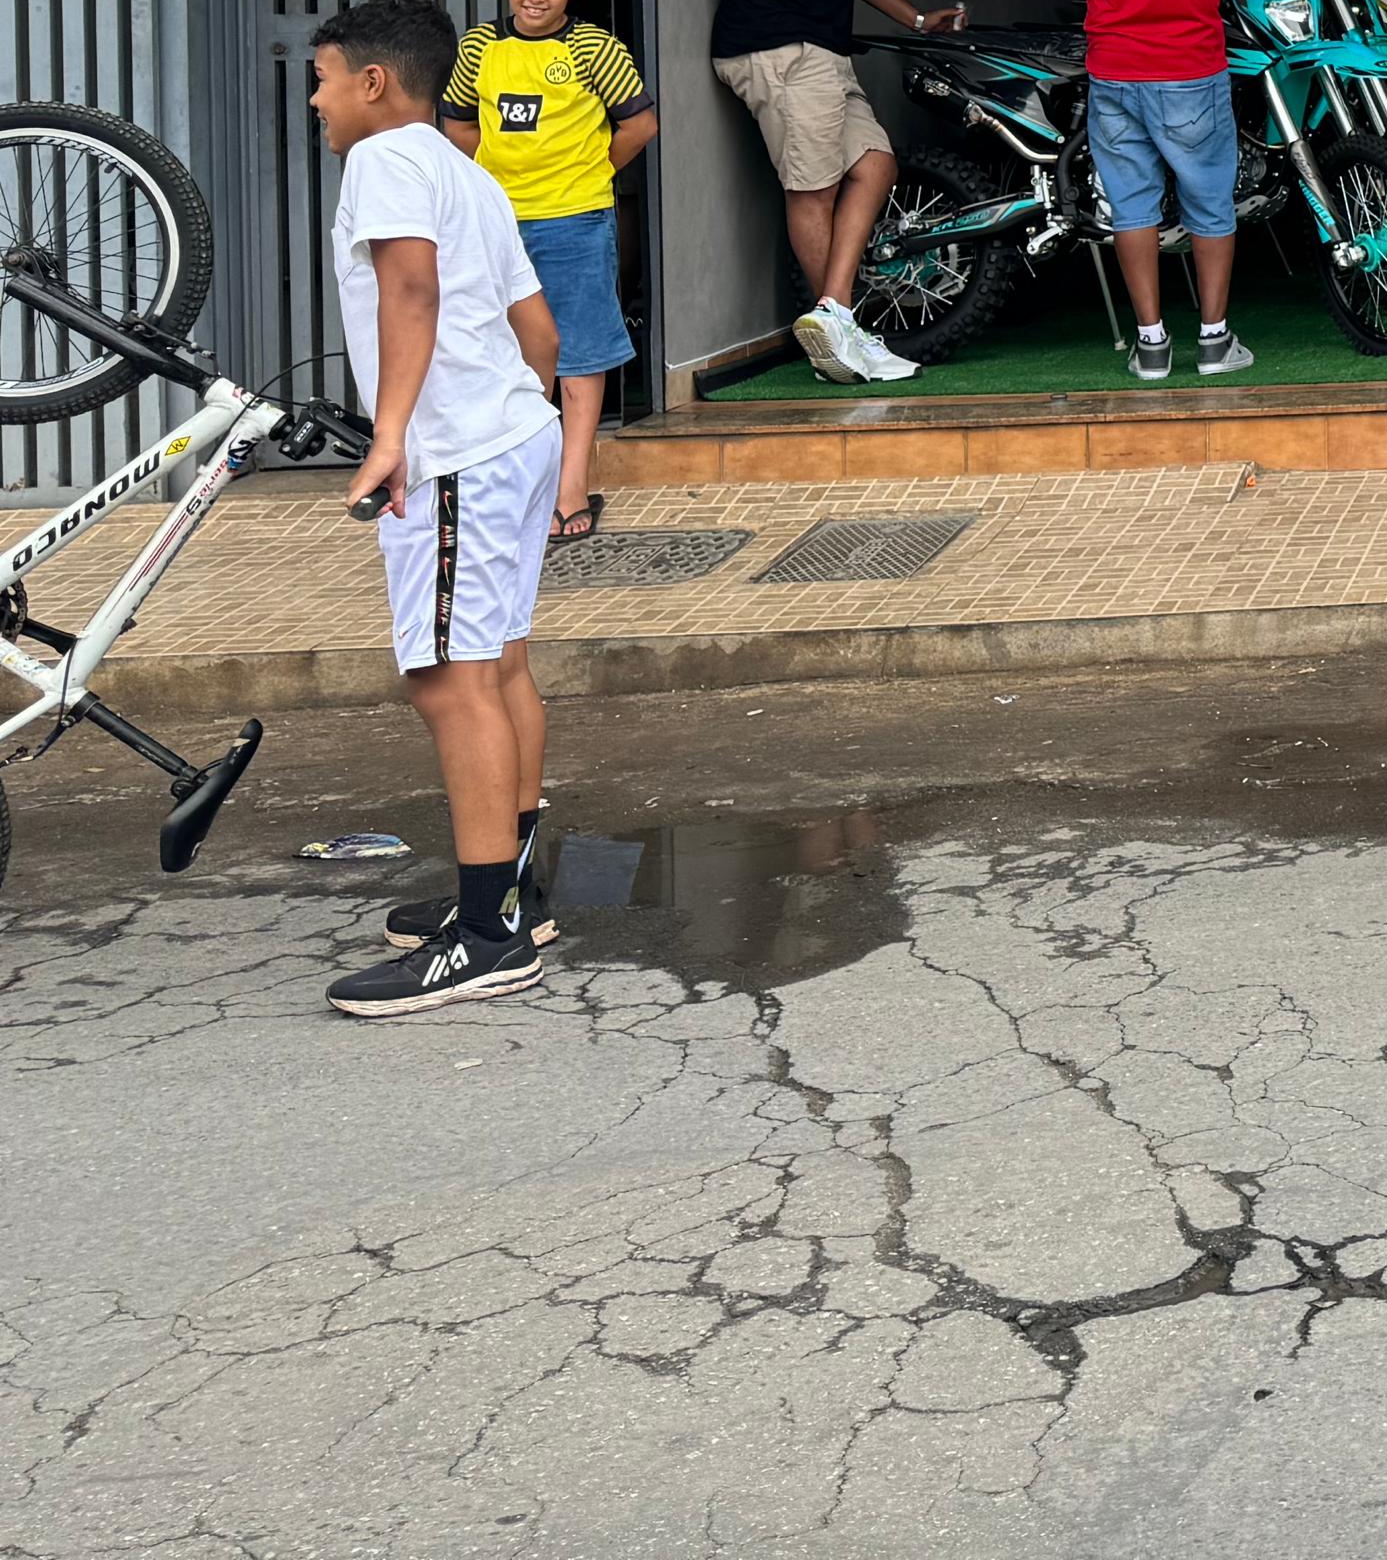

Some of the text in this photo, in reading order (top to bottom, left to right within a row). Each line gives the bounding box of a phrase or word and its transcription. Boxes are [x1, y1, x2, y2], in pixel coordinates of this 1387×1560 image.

[500, 102, 537, 123] 1&1
[12, 450, 162, 573] MONACO
[438, 591, 452, 626] NIKE
